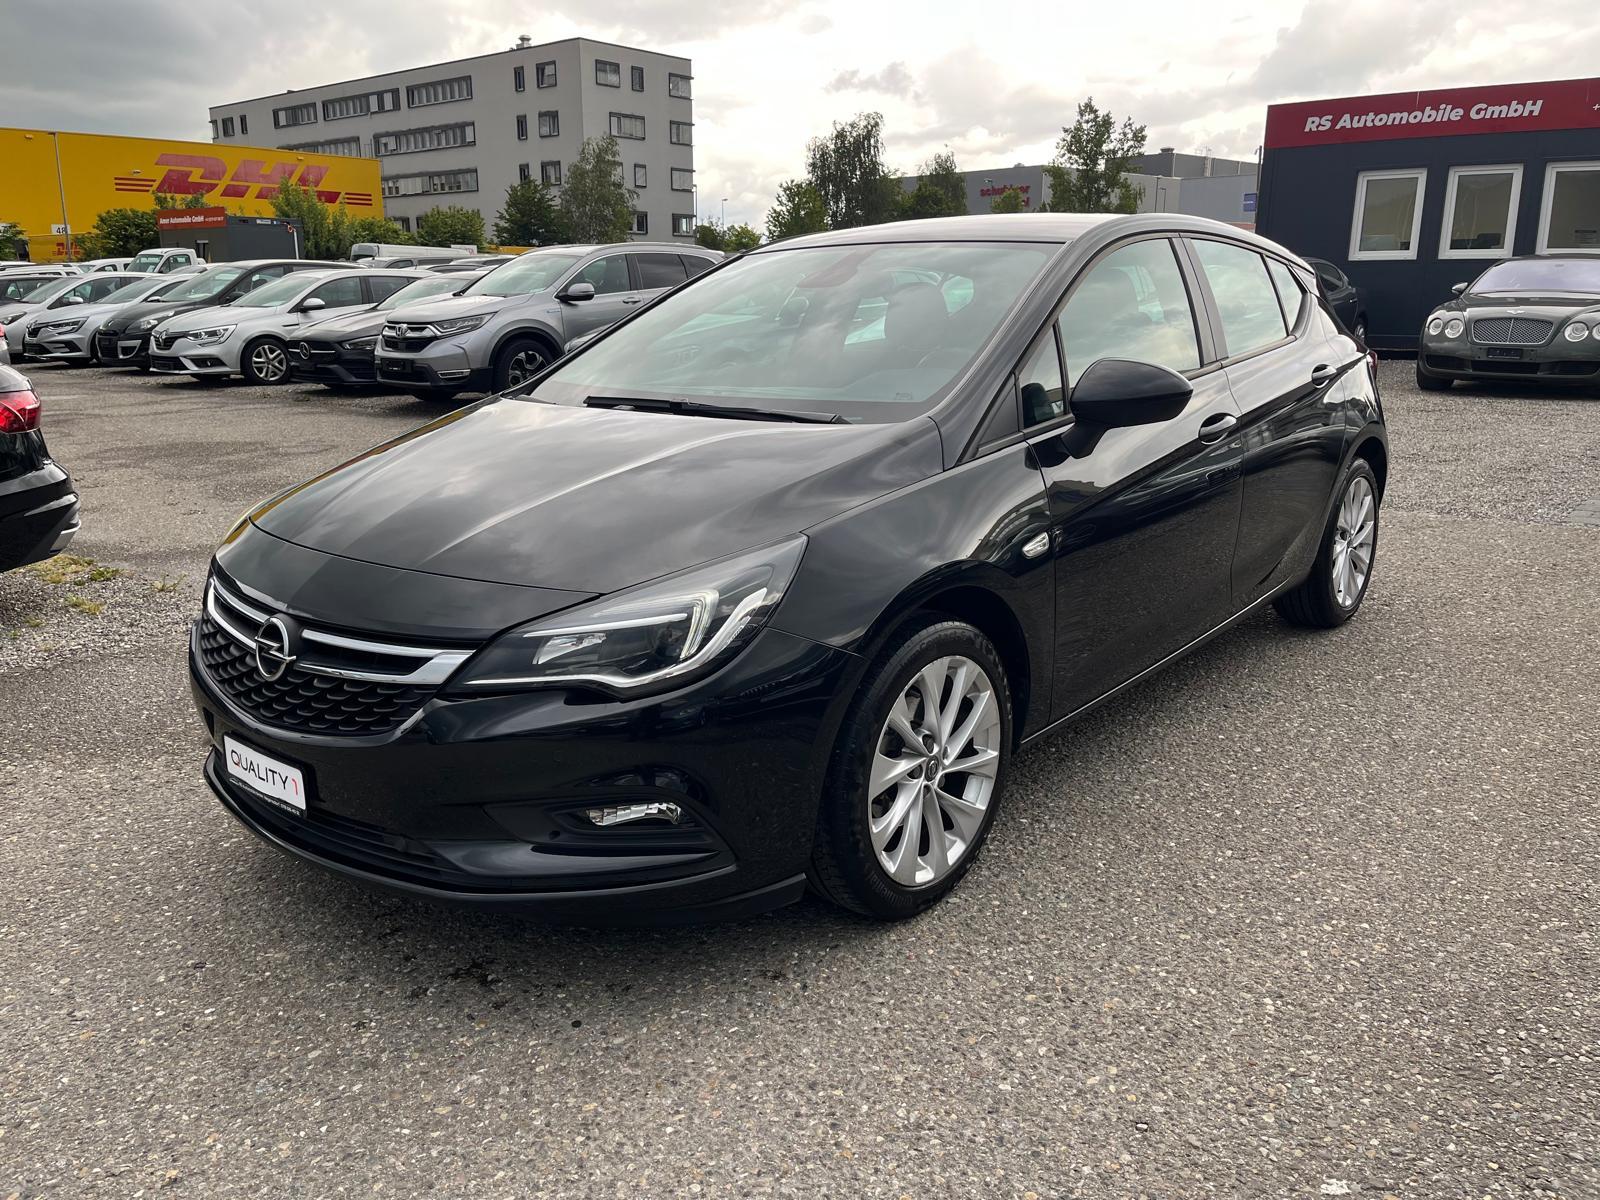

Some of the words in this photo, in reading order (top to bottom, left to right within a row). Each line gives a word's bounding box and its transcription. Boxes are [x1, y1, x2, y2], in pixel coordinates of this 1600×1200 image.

[1304, 114, 1333, 132] RS
[1335, 103, 1465, 130] Automobile
[1469, 99, 1543, 121] GmbH
[154, 153, 341, 204] DHL
[230, 749, 288, 790] QUALITY
[291, 778, 298, 796] 1
